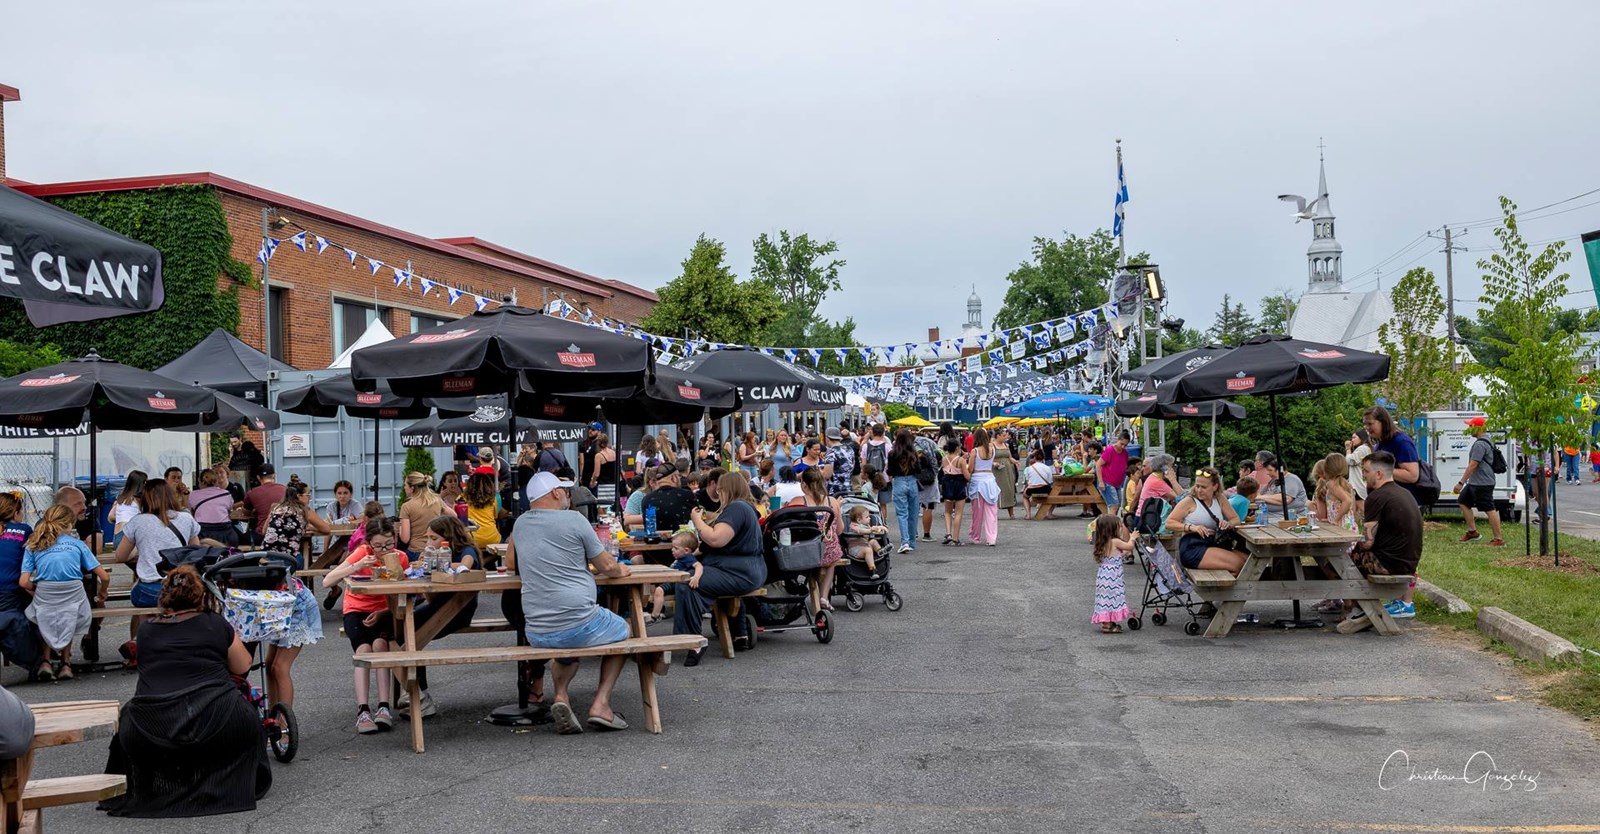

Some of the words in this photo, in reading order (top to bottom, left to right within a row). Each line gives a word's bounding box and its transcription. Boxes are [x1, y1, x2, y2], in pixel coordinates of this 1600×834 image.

[31, 251, 139, 300] CLAW
[561, 355, 593, 363] SLEEMAN
[1228, 380, 1253, 388] SLEEMAN
[750, 385, 796, 400] CLAW
[821, 391, 845, 403] CLAW
[441, 432, 484, 443] WHITE
[560, 428, 584, 440] CLAW
[402, 435, 423, 446] WHITE
